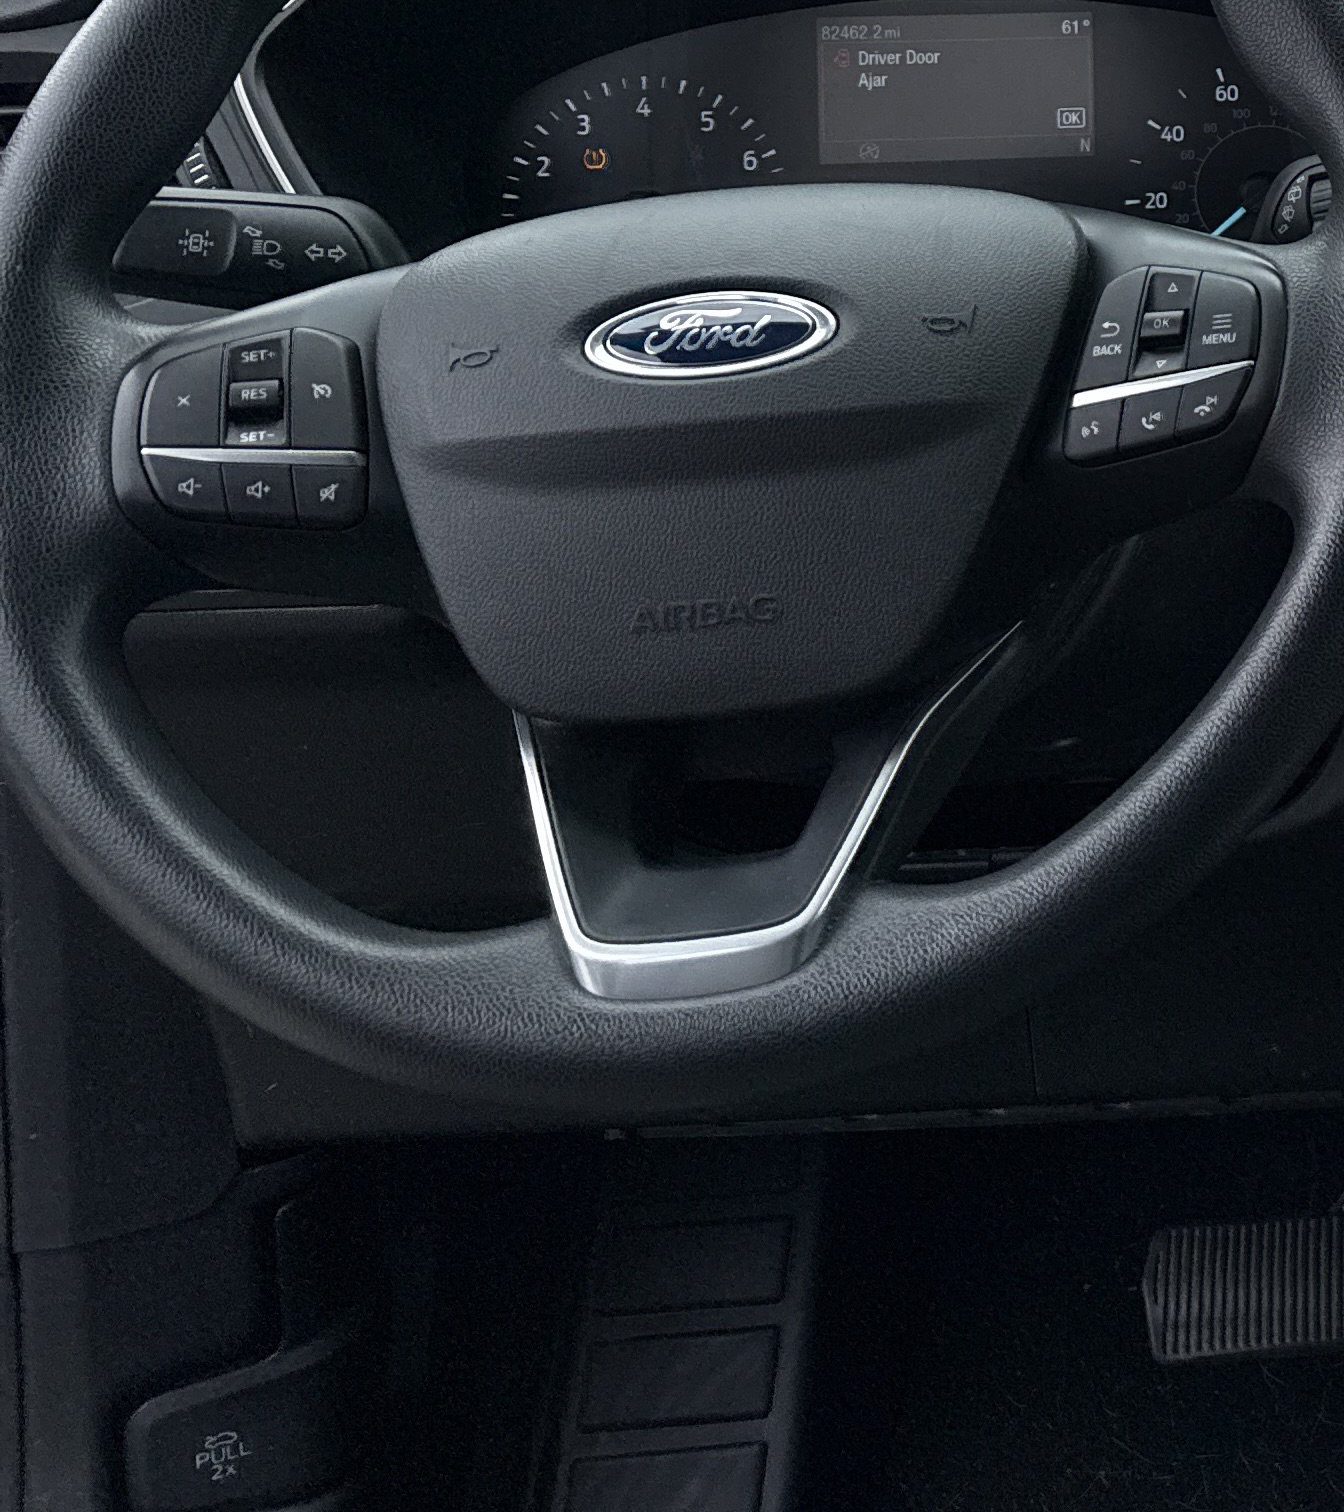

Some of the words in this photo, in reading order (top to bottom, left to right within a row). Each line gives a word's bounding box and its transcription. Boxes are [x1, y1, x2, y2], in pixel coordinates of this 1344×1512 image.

[858, 50, 902, 66] Driver
[906, 49, 941, 65] Door
[858, 72, 888, 90] Ajar
[1215, 84, 1239, 103] 60
[636, 97, 652, 118] 4
[577, 114, 591, 135] 3
[700, 111, 715, 132] 5
[1062, 111, 1081, 125] OK
[1160, 124, 1185, 143] 40
[536, 156, 551, 177] 2
[743, 150, 758, 171] 6
[1145, 192, 1168, 210] 20
[643, 307, 773, 356] Ford
[1201, 332, 1236, 345] MENU
[1092, 343, 1123, 357] BACK
[241, 388, 267, 400] RES
[631, 593, 785, 636] AIRBAG
[195, 1441, 253, 1470] PULL
